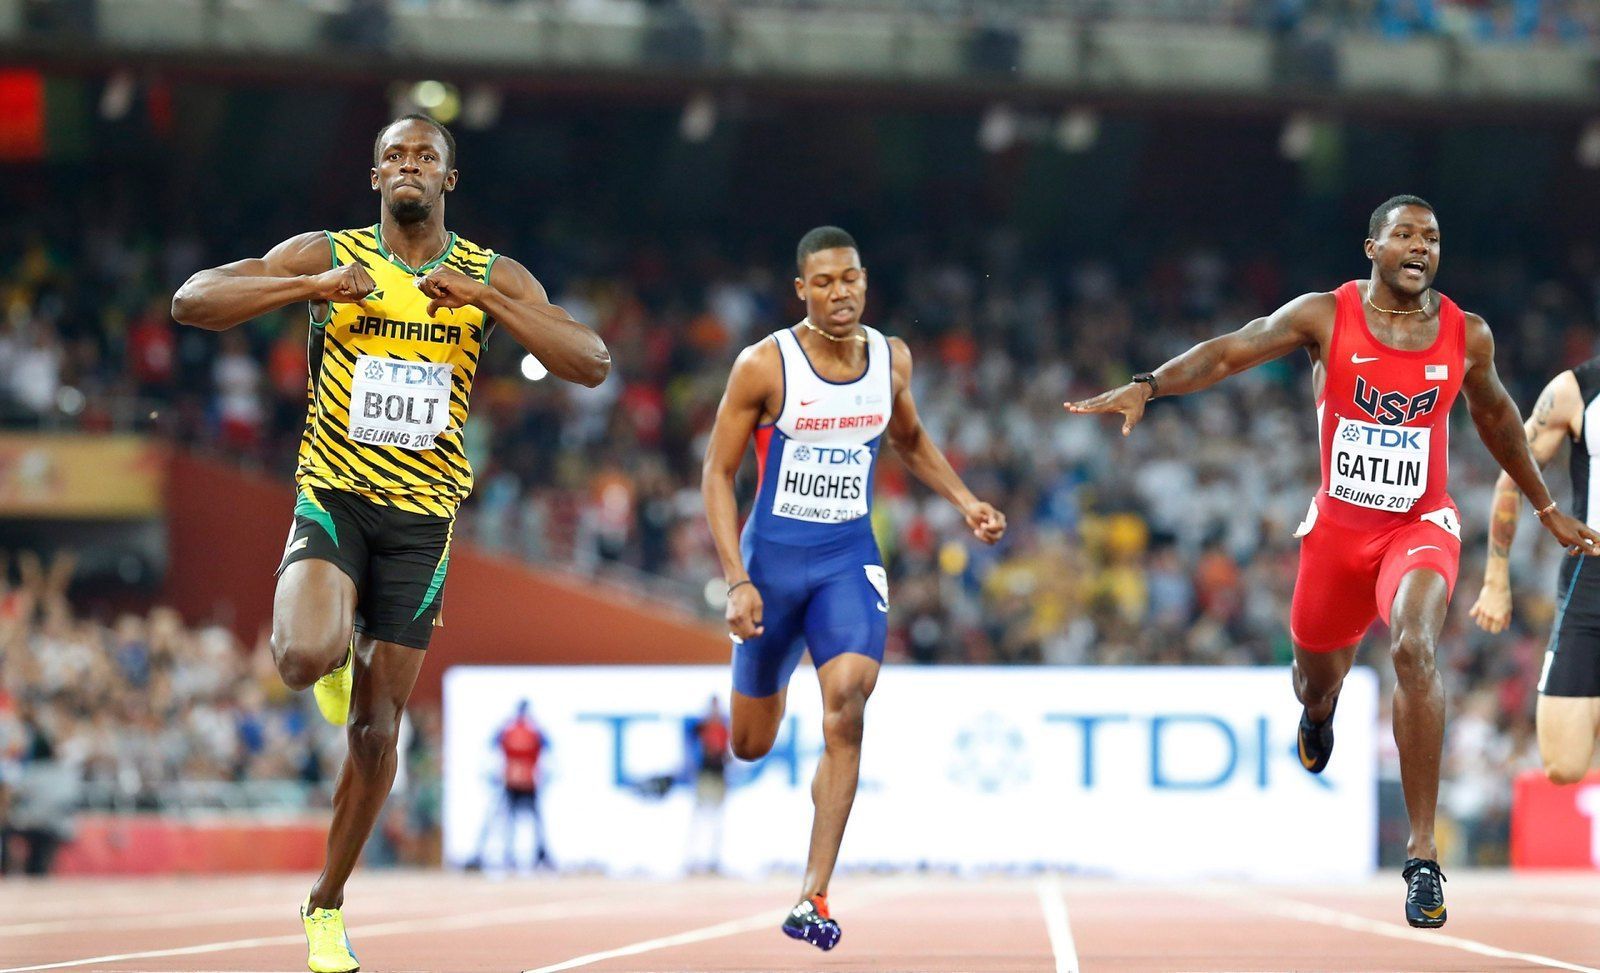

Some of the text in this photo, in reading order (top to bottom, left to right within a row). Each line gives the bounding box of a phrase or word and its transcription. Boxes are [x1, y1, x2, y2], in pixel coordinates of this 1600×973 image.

[350, 315, 461, 345] JAMAICA
[385, 362, 445, 387] TDK
[363, 391, 439, 425] BOLT
[1353, 374, 1440, 426] USA
[795, 417, 836, 430] GREAT
[353, 426, 436, 448] BEIJING 201
[1361, 426, 1421, 450] TDK
[812, 447, 862, 465] TDK
[1337, 451, 1421, 487] GATLIN
[784, 470, 862, 500] HUGHES
[1334, 485, 1385, 506] BEIJING
[780, 502, 831, 520] BEIJING
